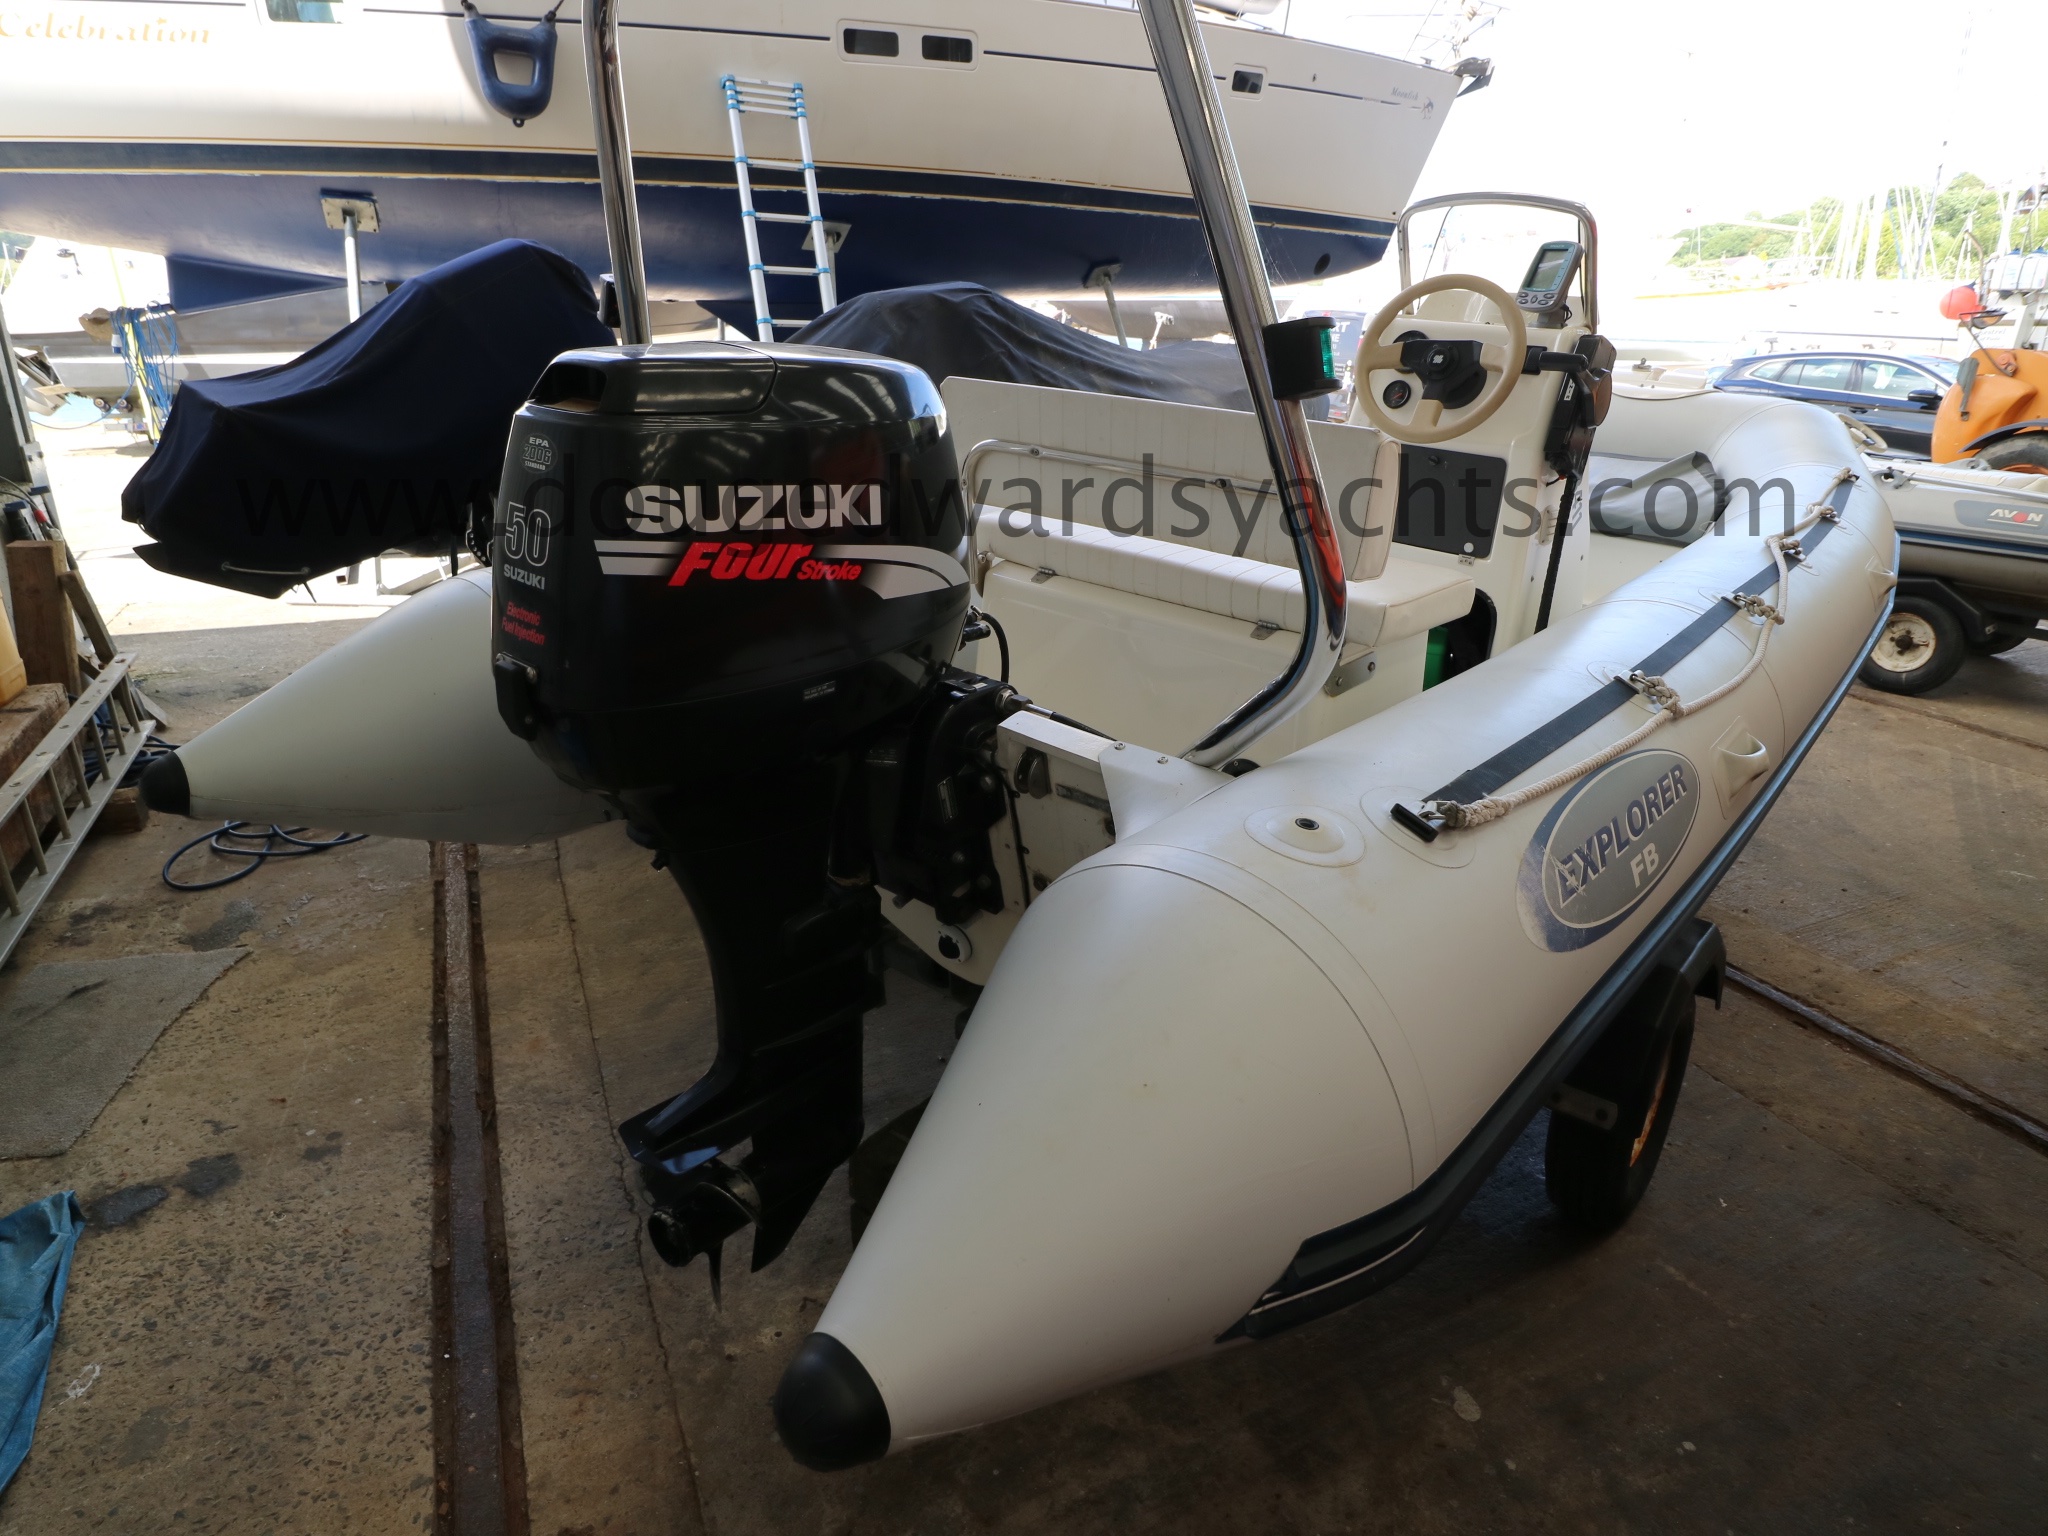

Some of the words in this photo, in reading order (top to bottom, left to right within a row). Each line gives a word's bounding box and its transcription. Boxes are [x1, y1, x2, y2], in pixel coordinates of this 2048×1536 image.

[0, 12, 210, 44] Celebration
[522, 444, 552, 465] 2006
[529, 436, 550, 448] EPA
[524, 460, 546, 471] STANDARD
[625, 484, 882, 534] SUZUKI
[1989, 508, 2044, 523] AVON
[505, 501, 551, 567] 50
[503, 564, 546, 591] SUZUKI
[796, 559, 862, 581] Stroke
[506, 601, 542, 626] Electronic
[502, 616, 517, 635] Fuel
[515, 621, 546, 646] Injection
[1555, 764, 1688, 910] EXPLORER
[1629, 842, 1660, 889] FB
